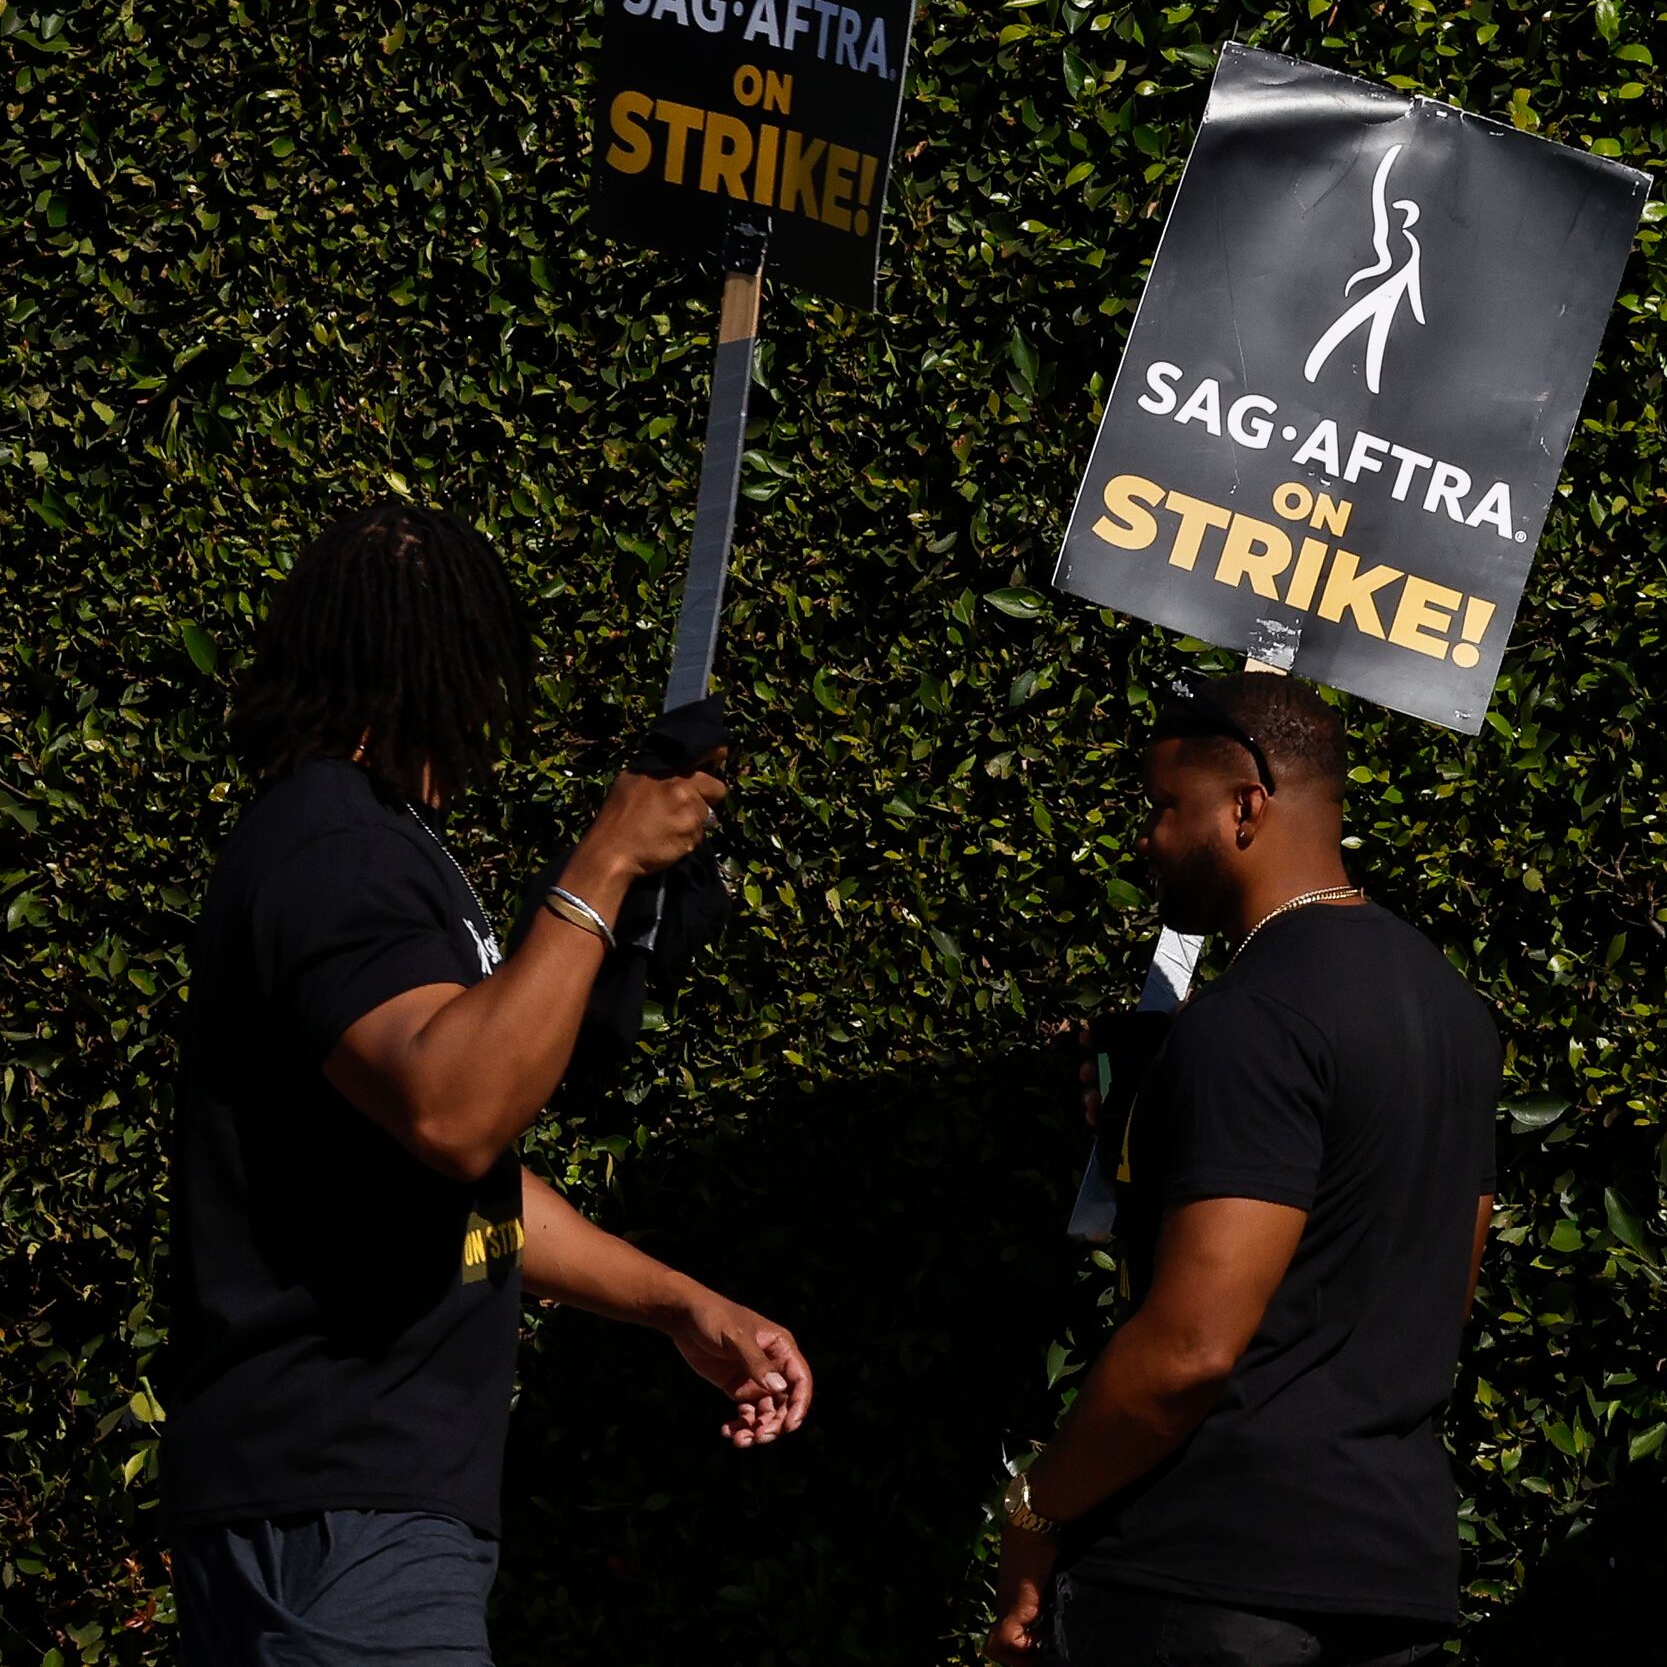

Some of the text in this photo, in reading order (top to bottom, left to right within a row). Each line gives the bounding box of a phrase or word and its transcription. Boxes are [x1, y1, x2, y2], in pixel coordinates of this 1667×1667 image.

[733, 64, 793, 115] ON
[605, 90, 878, 236] STRIKE!
[1271, 481, 1353, 537] ON
[1091, 474, 1497, 669] STRIKE!
